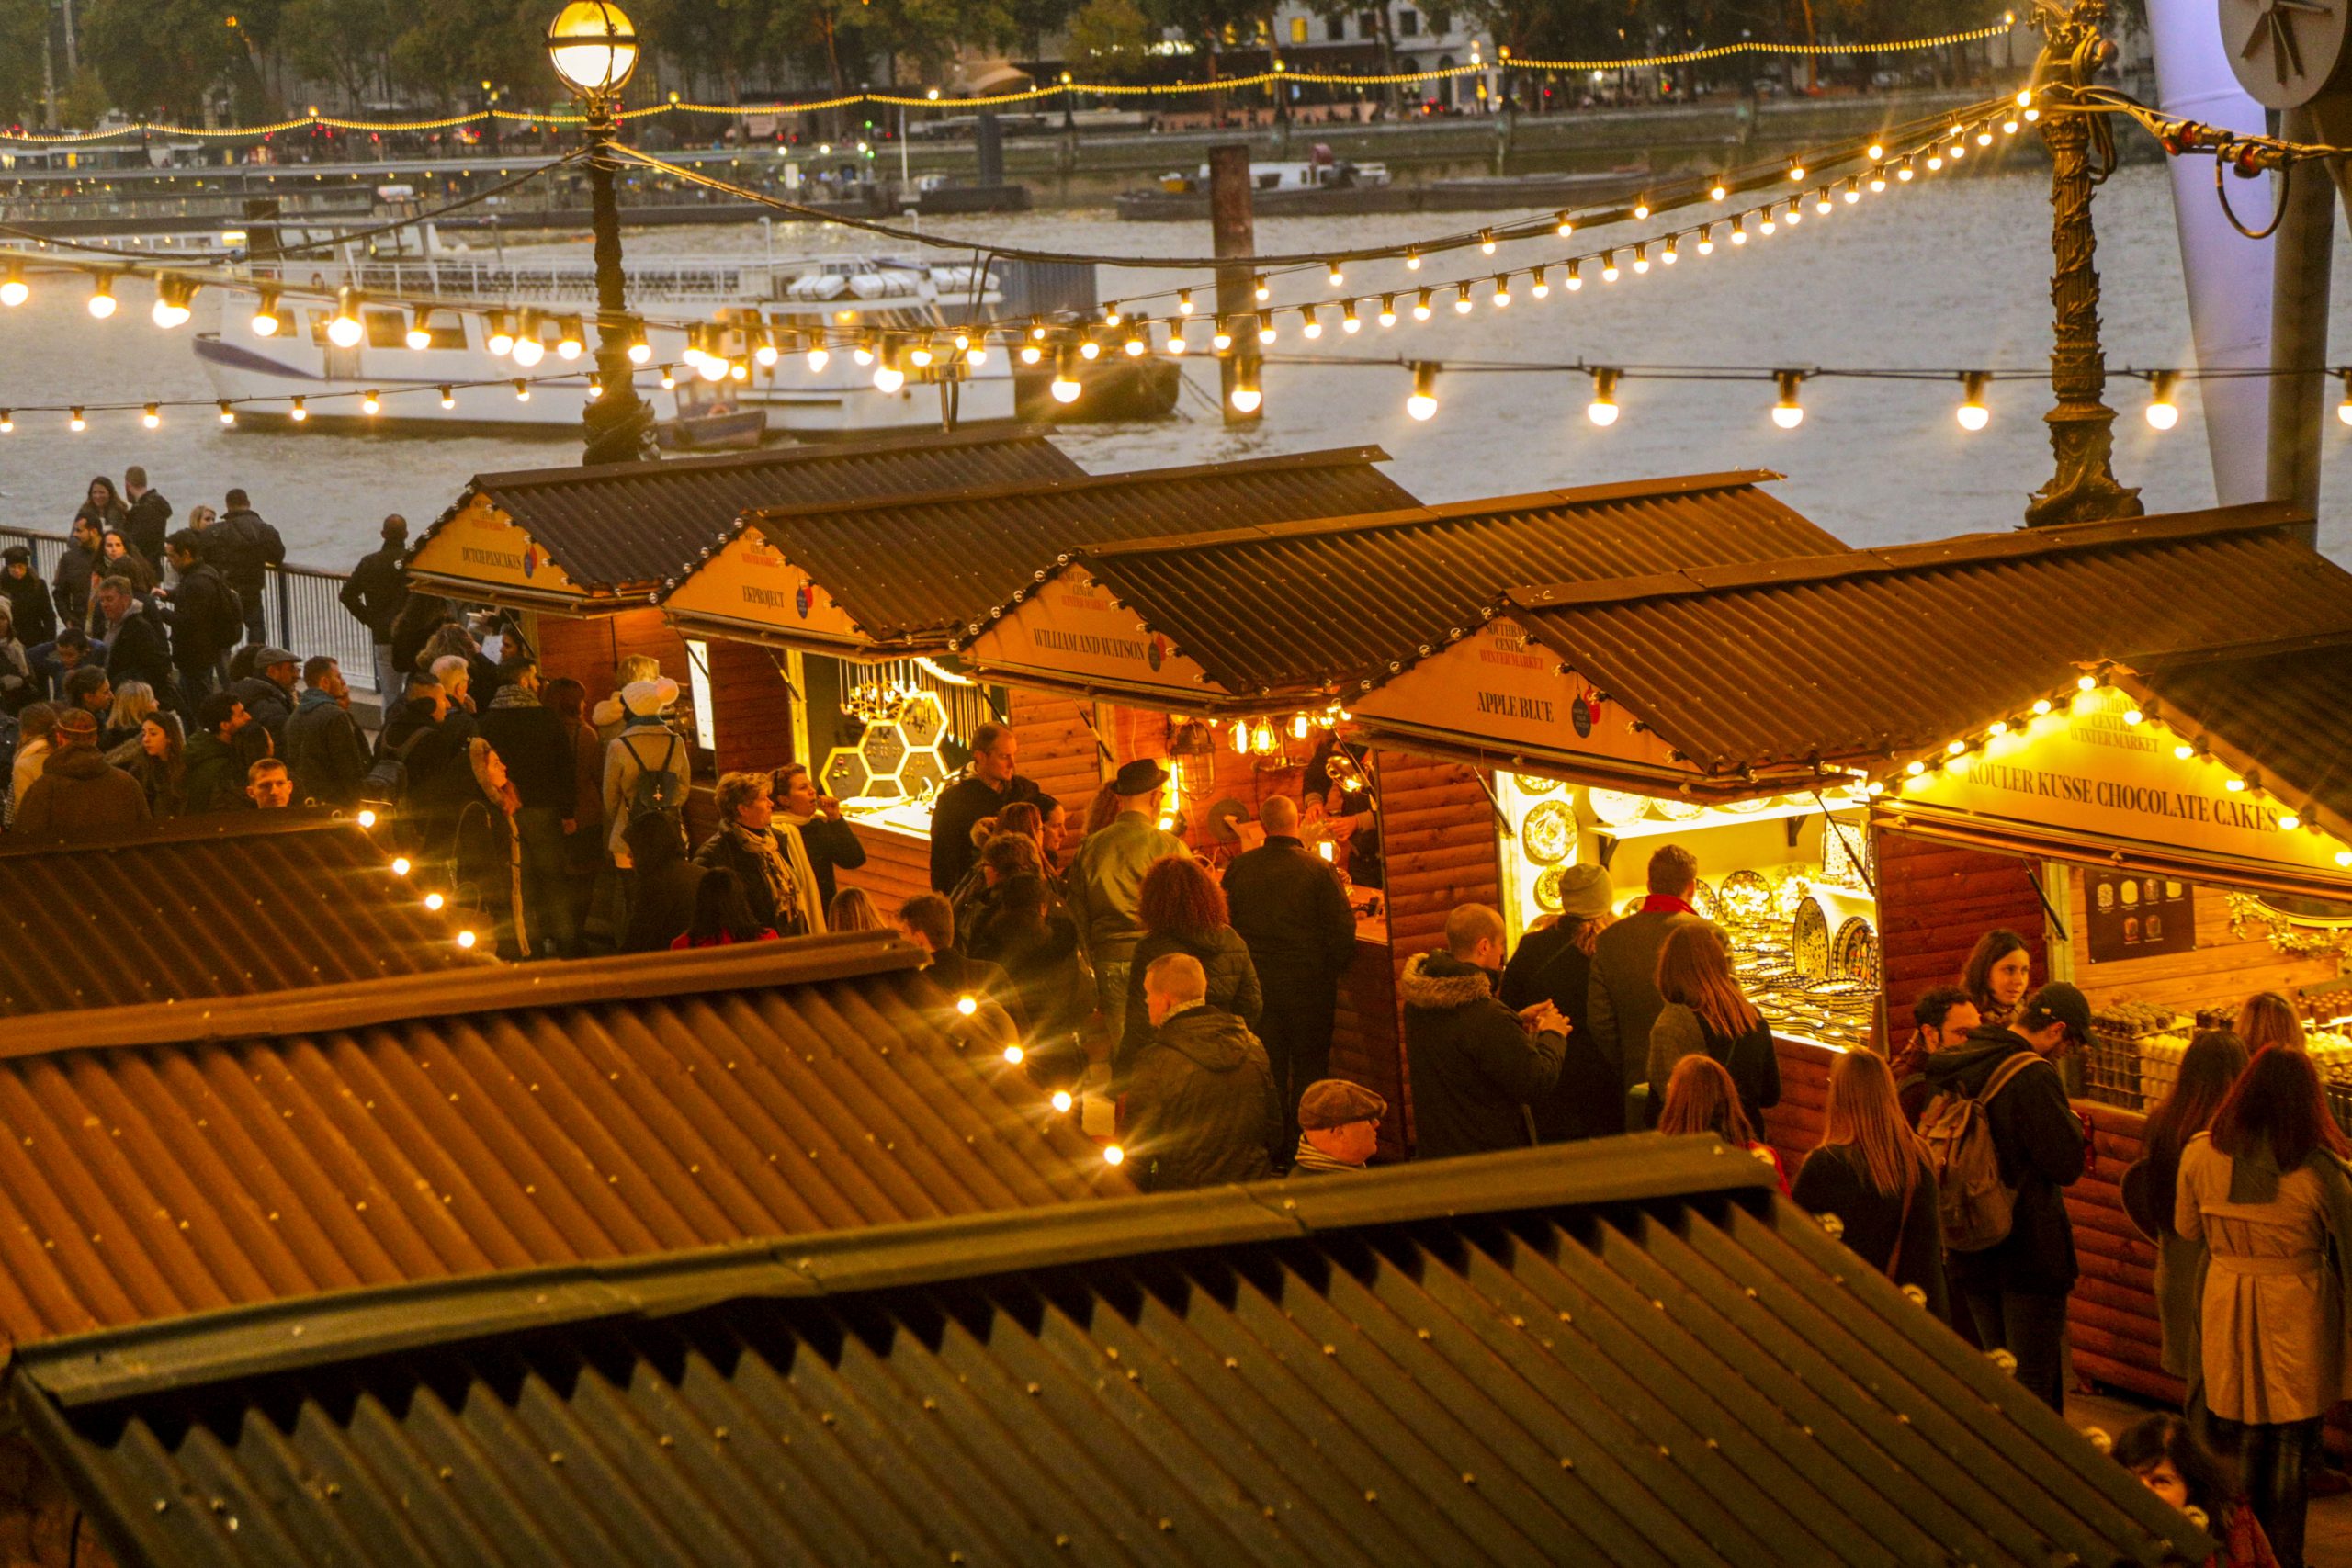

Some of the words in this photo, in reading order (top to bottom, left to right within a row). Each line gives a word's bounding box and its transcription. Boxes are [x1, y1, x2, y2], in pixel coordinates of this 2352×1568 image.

[1033, 628, 1078, 651] WILLIAM
[1079, 635, 1101, 655] AND
[1101, 637, 1146, 660] WATSON
[1480, 649, 1511, 665] WINTER
[1511, 652, 1544, 671] MARKET
[1477, 691, 1518, 716] APPLE
[1521, 697, 1554, 723] BLUE
[2070, 727, 2111, 746] WINTER
[2112, 732, 2159, 752] MARKET
[2037, 771, 2093, 804] KUSSE
[2097, 780, 2210, 822] CHOCOLATE
[2214, 799, 2279, 833] CAKES
